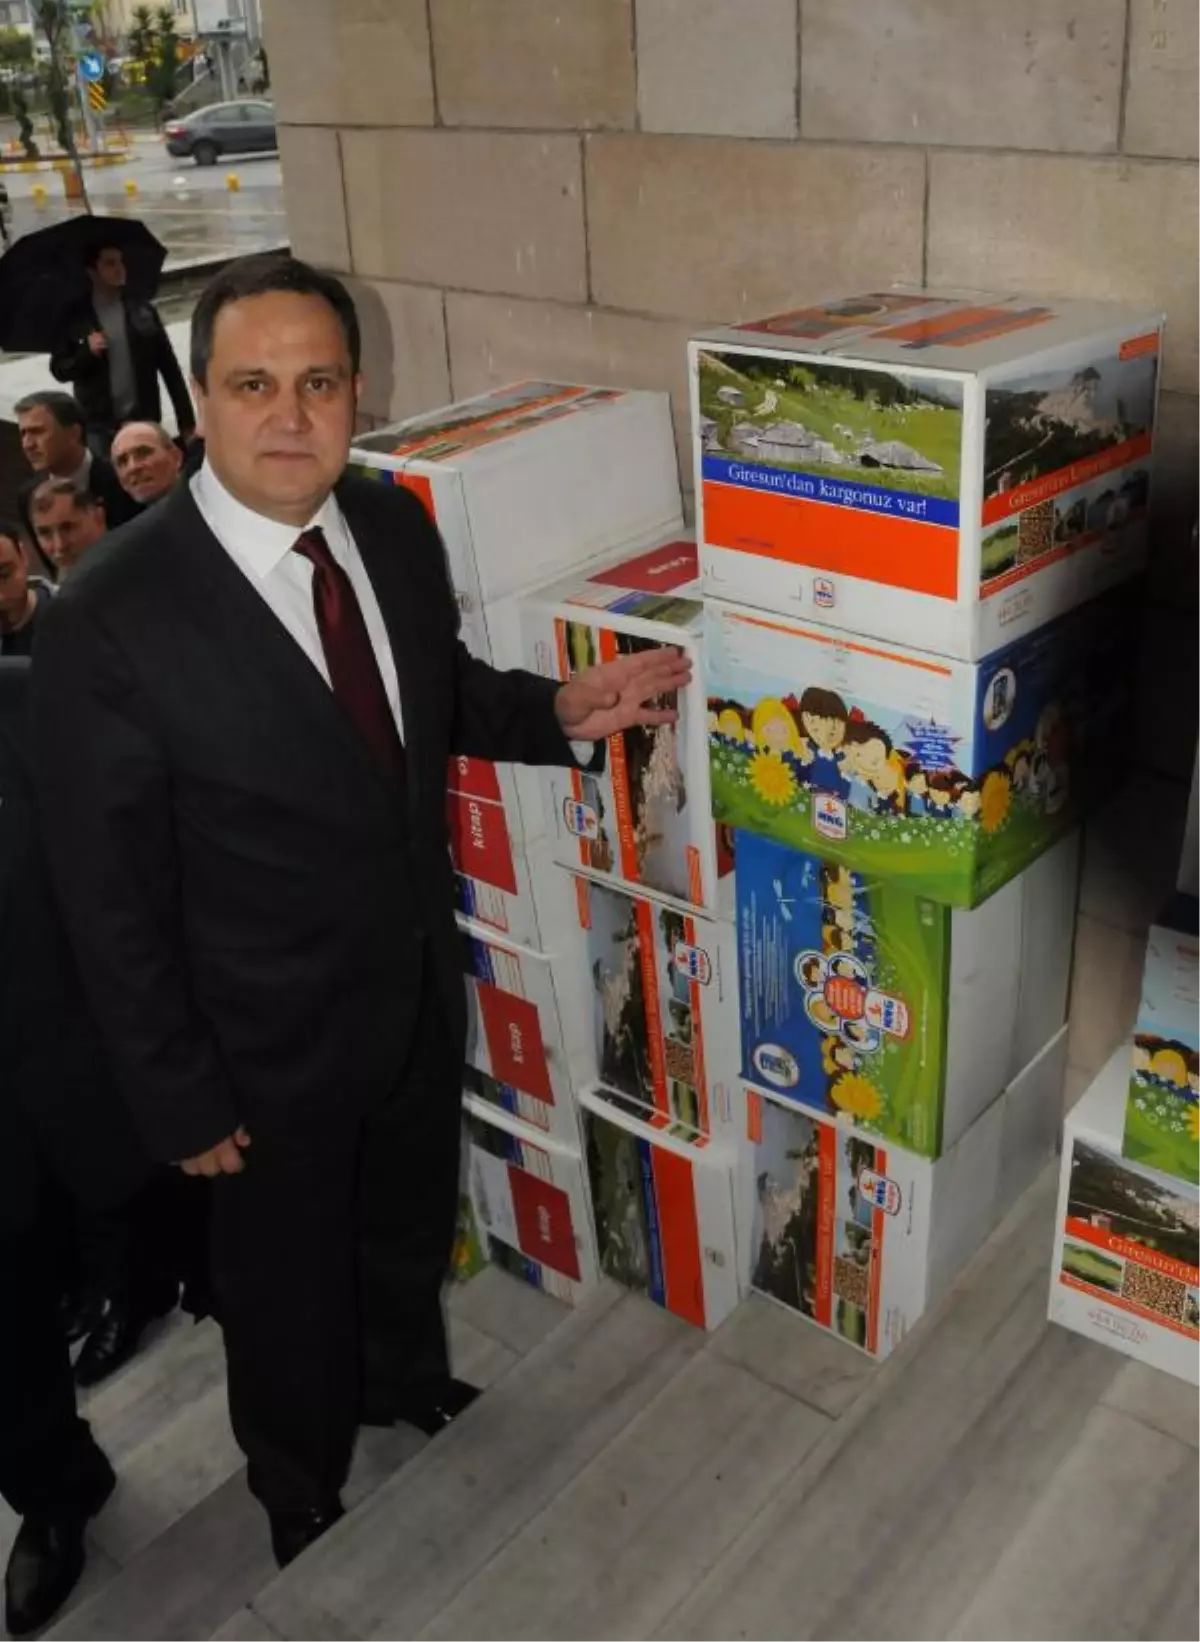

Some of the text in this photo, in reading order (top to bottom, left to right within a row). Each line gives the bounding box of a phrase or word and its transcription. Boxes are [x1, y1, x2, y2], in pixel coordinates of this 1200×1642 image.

[727, 463, 927, 516] Giresun'dan kargonuz var!
[468, 802, 486, 849] kitap
